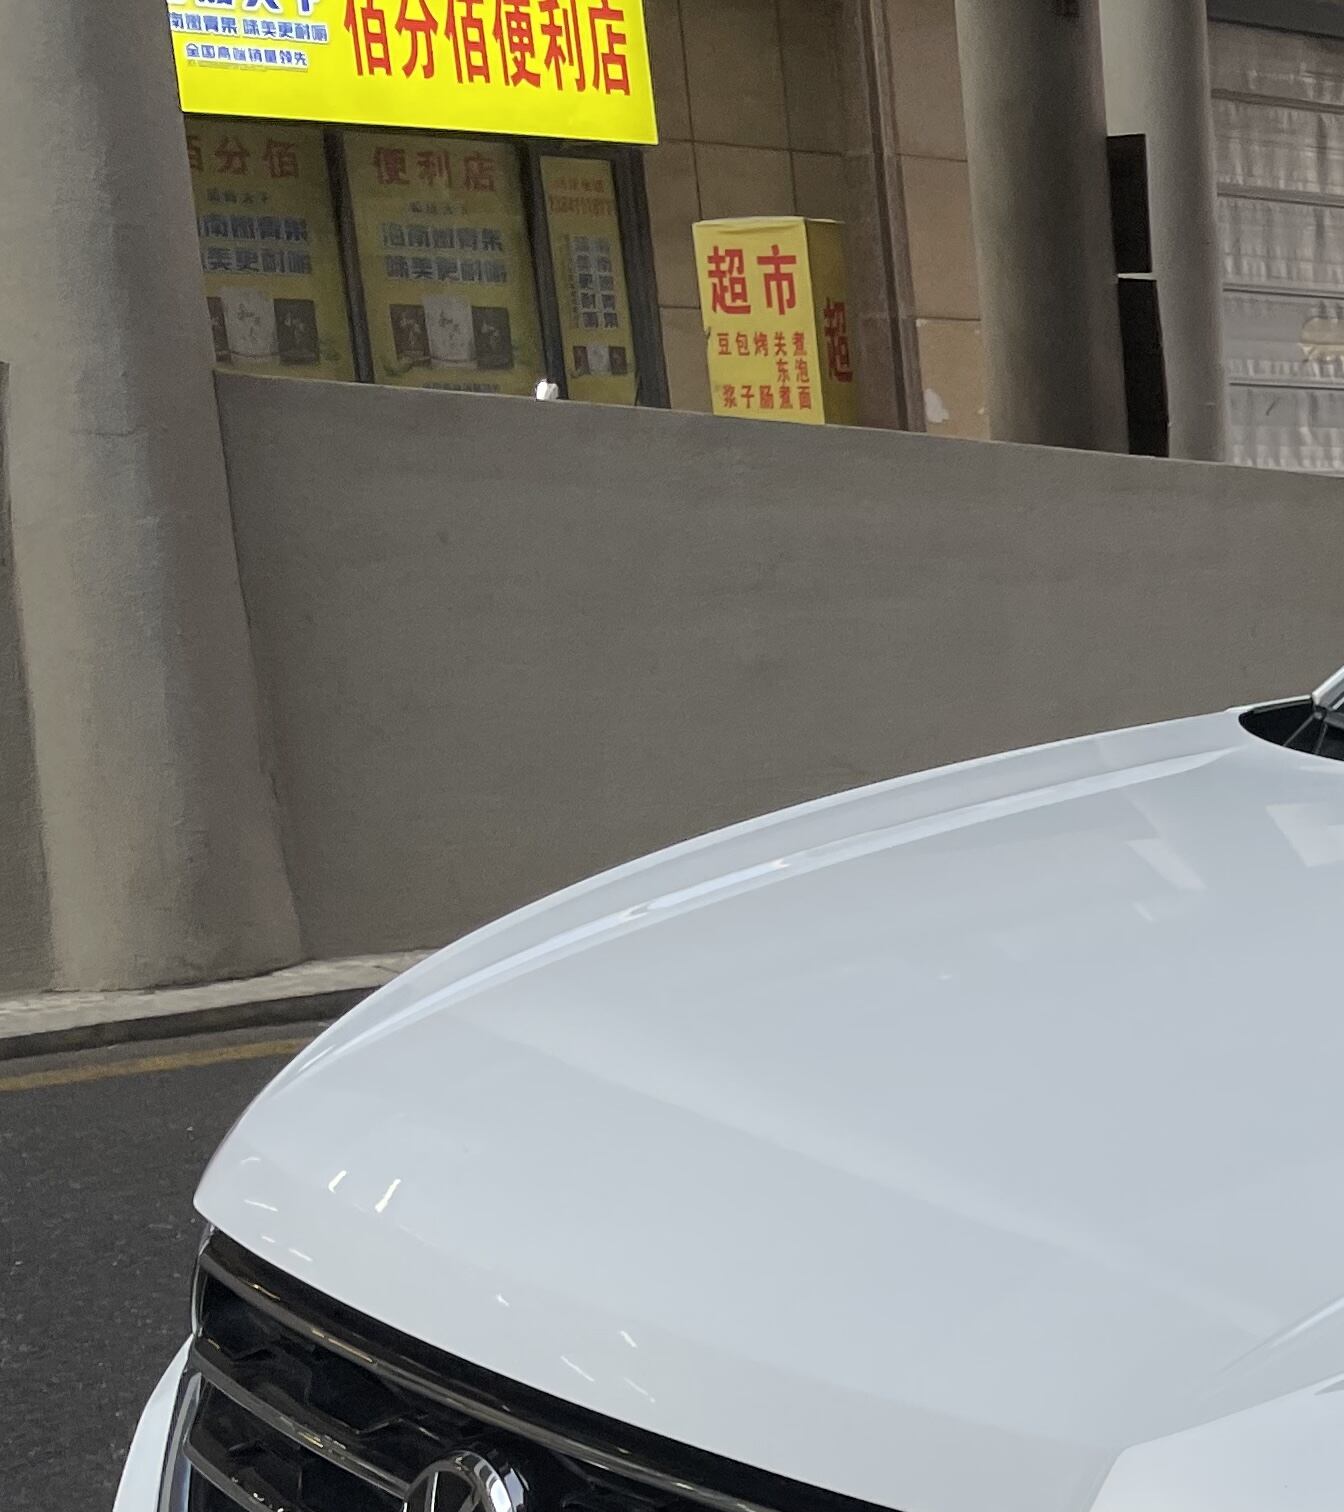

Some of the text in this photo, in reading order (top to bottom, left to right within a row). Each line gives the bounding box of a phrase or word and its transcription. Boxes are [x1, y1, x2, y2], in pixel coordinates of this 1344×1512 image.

[344, 0, 631, 96] 佰分佰便利店
[707, 244, 797, 316] 超市
